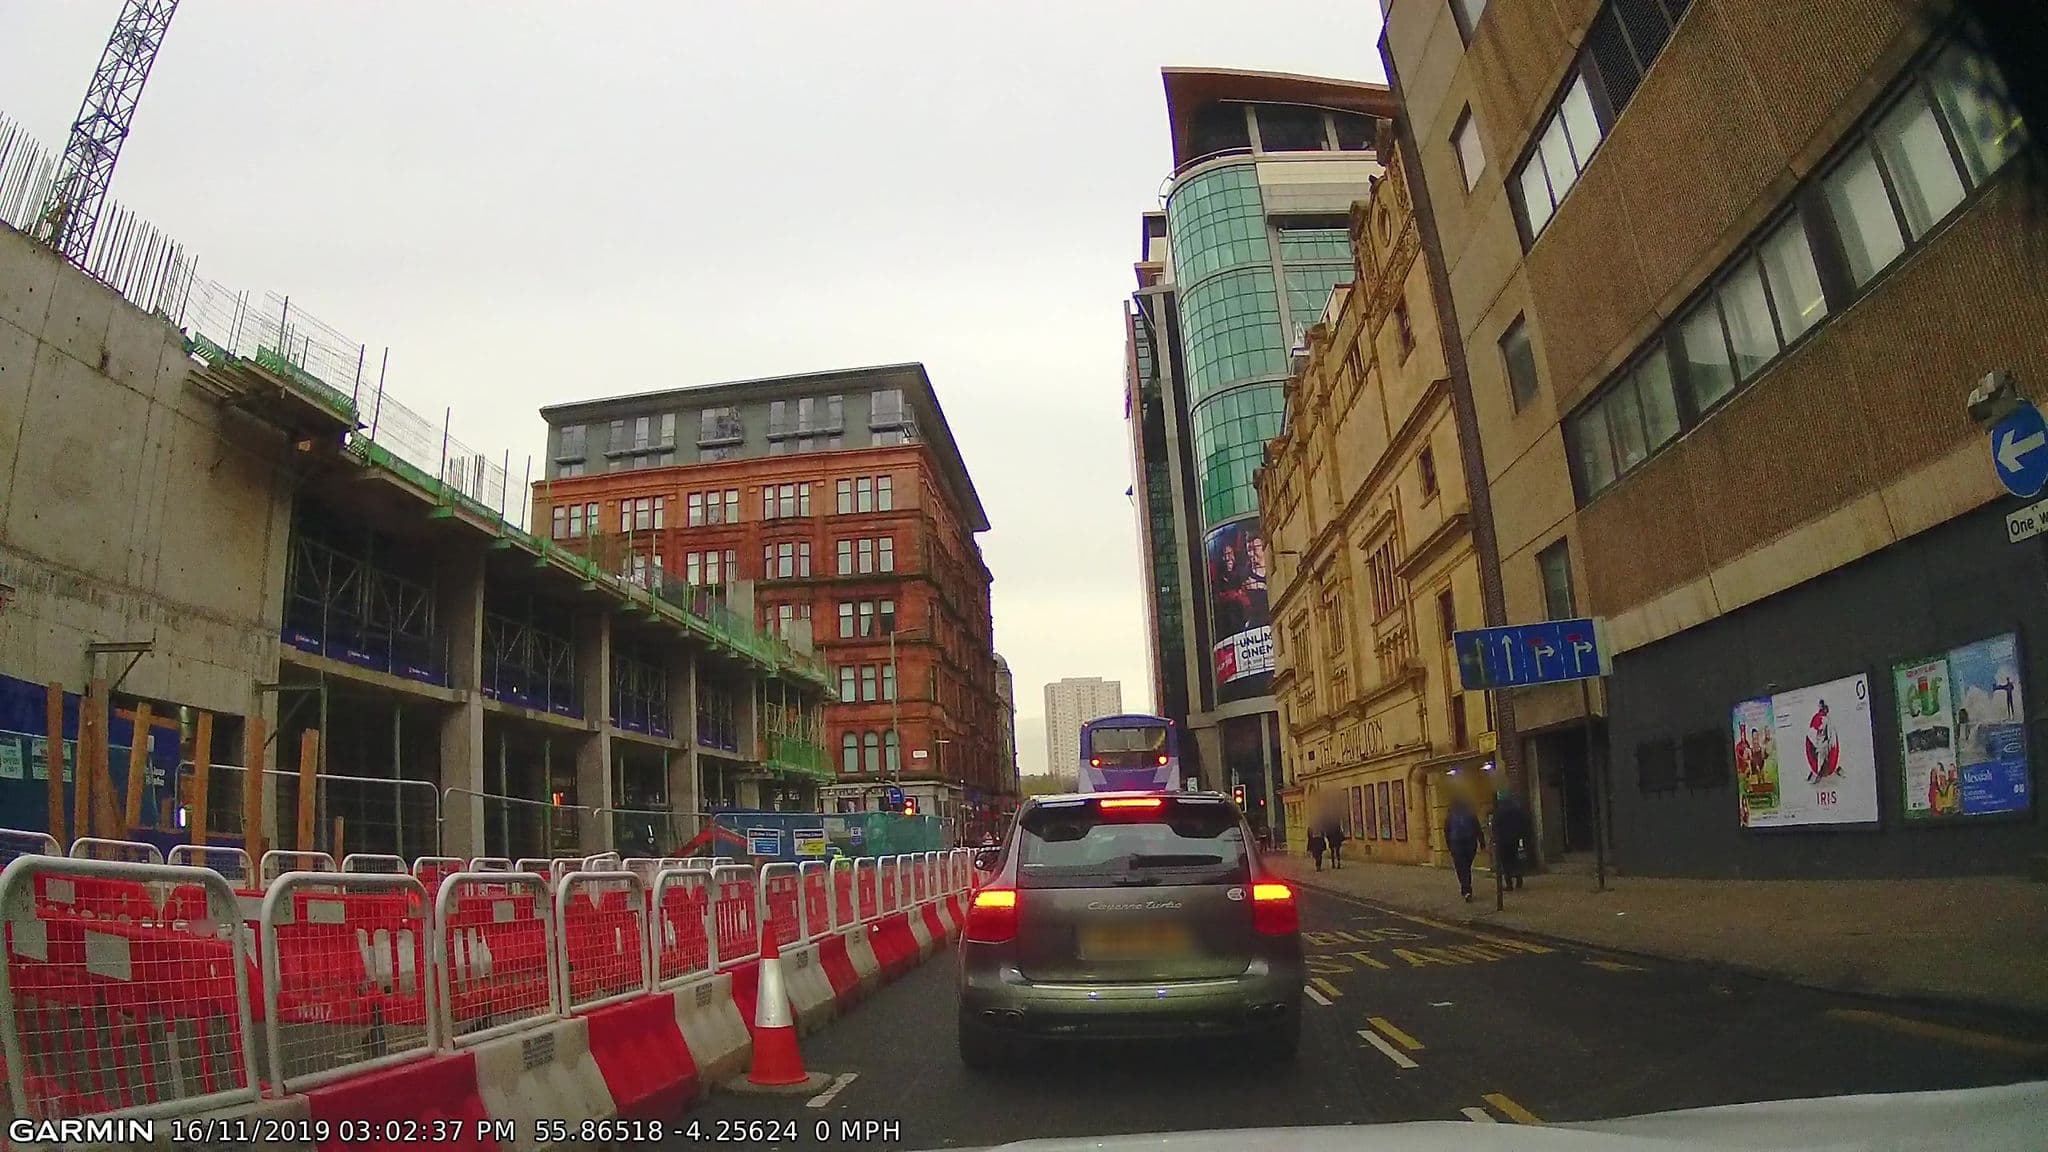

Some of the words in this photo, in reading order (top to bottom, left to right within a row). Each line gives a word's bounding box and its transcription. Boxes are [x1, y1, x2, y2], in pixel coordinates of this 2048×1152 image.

[2010, 518, 2034, 535] One
[1318, 735, 1341, 769] THE
[1816, 790, 1837, 806] IRIS
[1088, 902, 1142, 912] Cayenne
[1301, 928, 1428, 946] BUS
